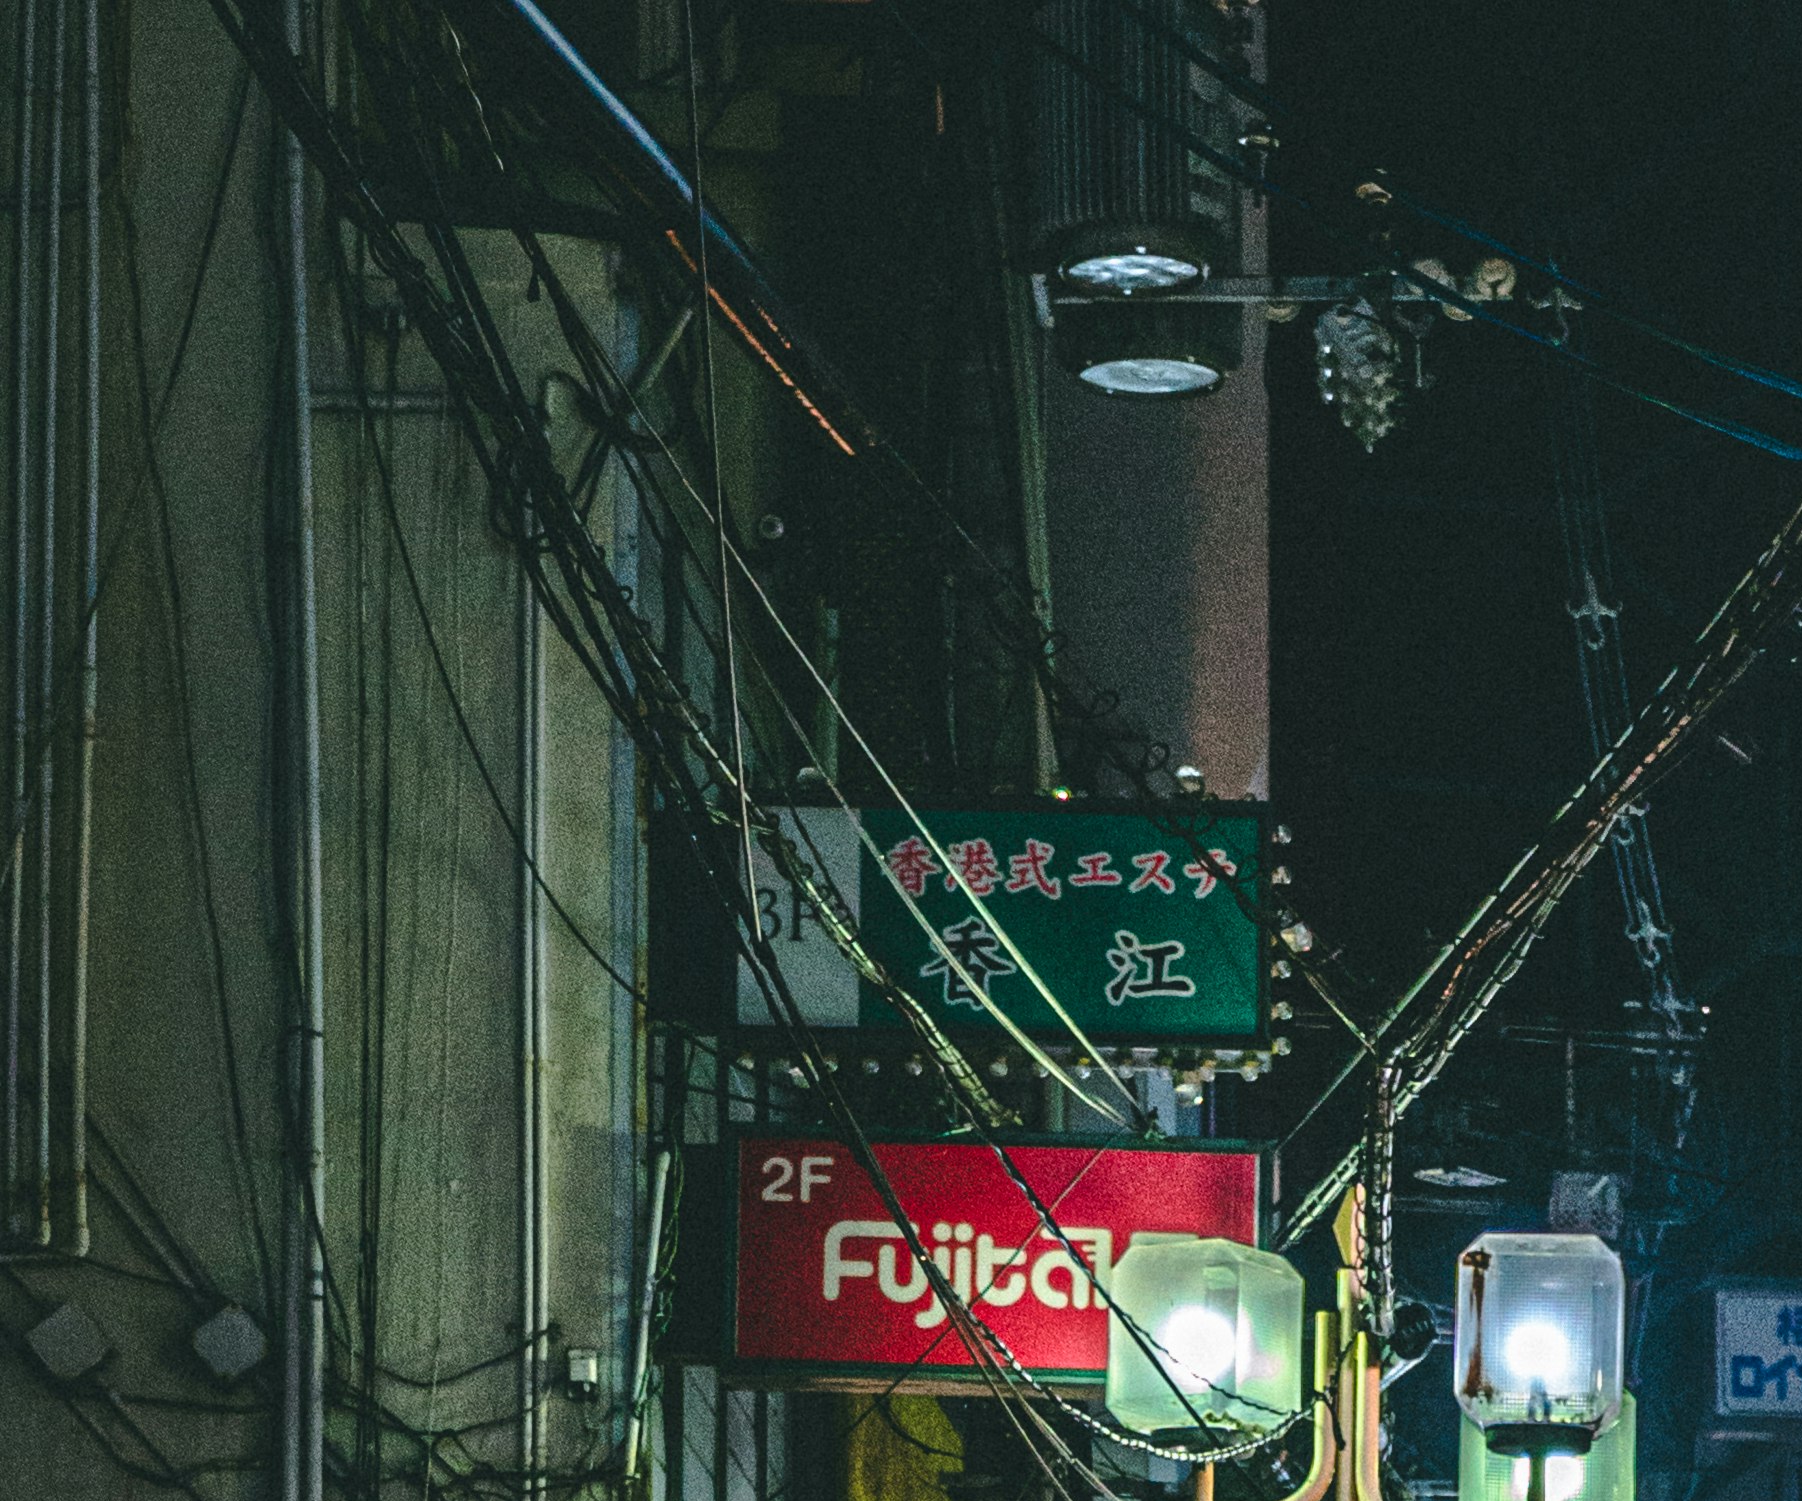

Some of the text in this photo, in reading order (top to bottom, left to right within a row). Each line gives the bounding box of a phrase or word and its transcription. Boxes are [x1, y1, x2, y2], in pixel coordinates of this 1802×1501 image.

[883, 837, 1234, 899] 香港式エステ
[921, 917, 1196, 1010] 香江
[761, 1156, 833, 1204] 2F
